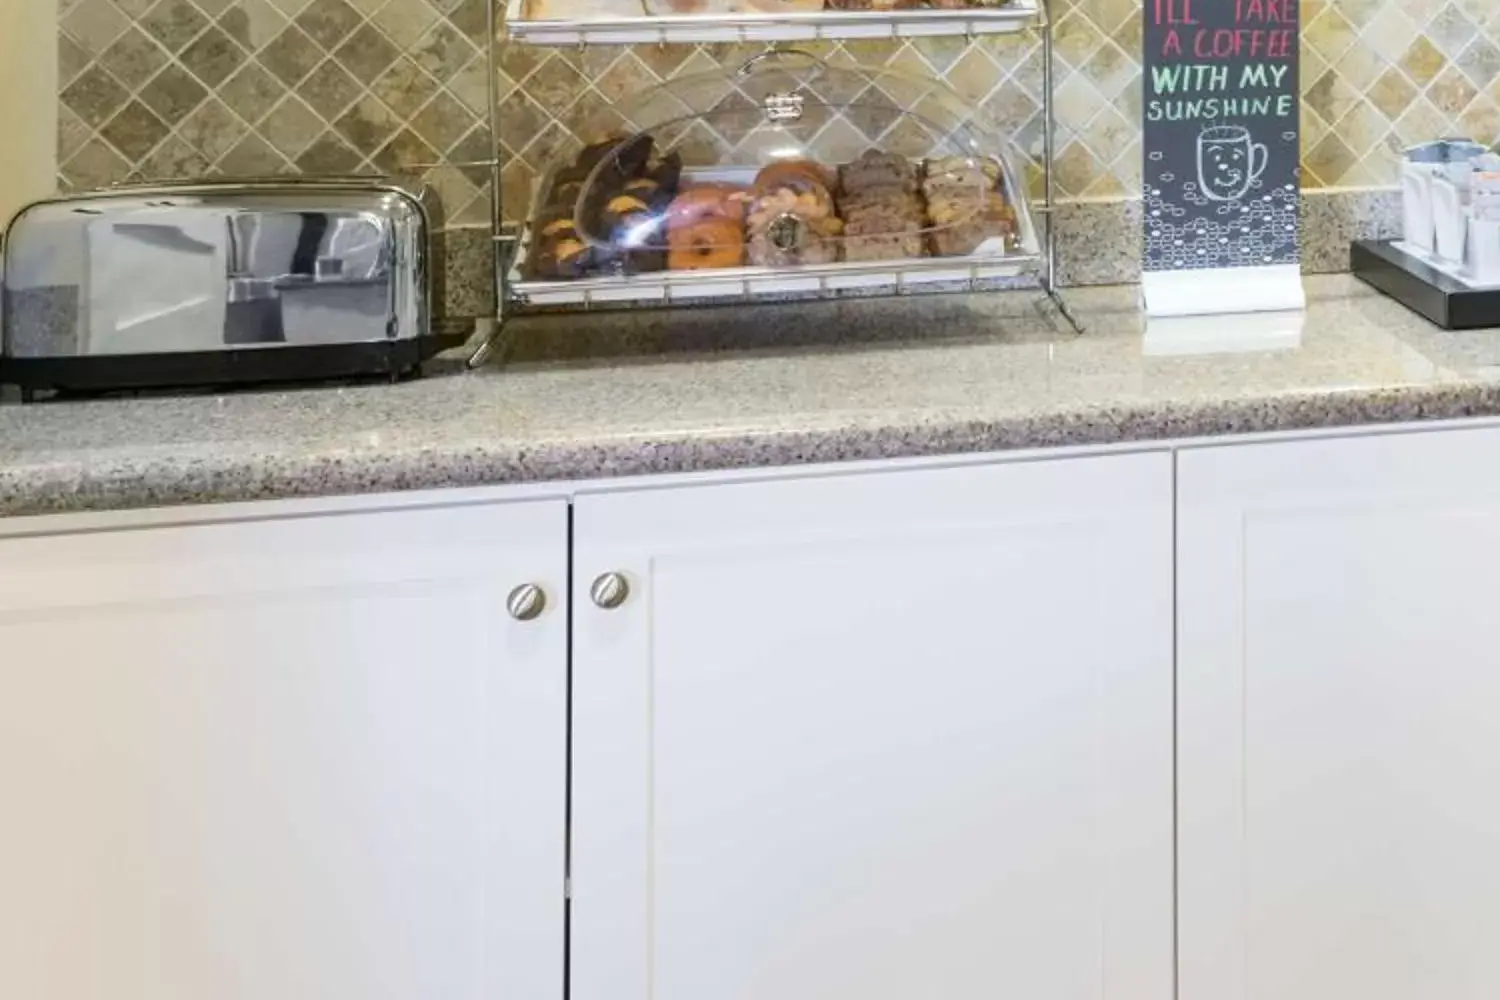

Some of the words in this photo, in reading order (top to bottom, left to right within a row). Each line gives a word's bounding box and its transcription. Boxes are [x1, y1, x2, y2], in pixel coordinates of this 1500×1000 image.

[1162, 28, 1183, 58] A
[1193, 28, 1297, 58] COFFEE
[1151, 63, 1229, 95] WITH
[1239, 63, 1289, 89] MY
[1147, 95, 1293, 121] SUNSHINE
